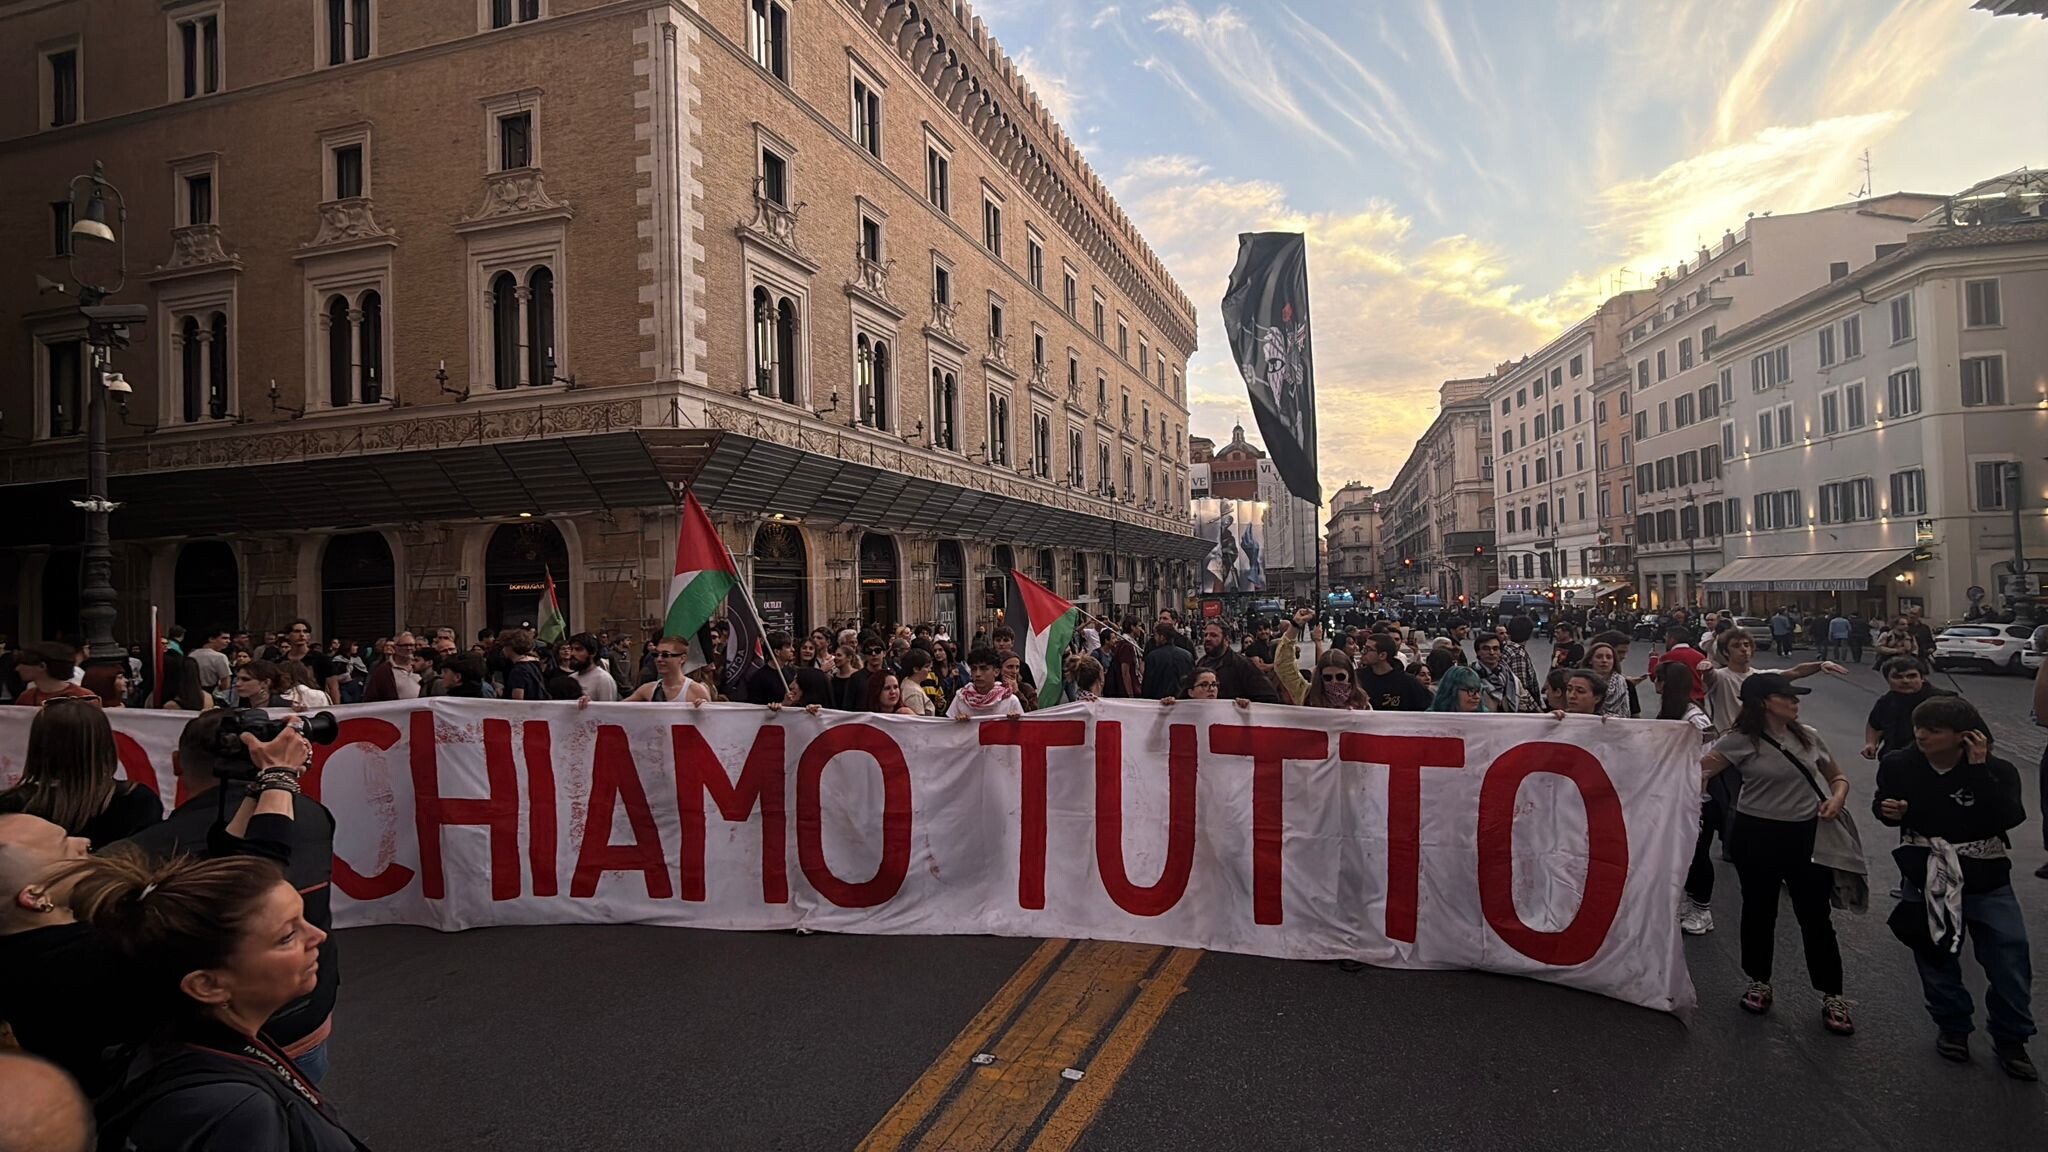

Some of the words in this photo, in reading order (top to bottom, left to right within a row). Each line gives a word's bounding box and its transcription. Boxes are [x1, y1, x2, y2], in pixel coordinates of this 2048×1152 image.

[1260, 464, 1271, 473] VI
[1192, 477, 1206, 486] VE
[459, 578, 466, 589] P
[763, 601, 782, 609] OUTLET
[979, 721, 1629, 966] TUTTO
